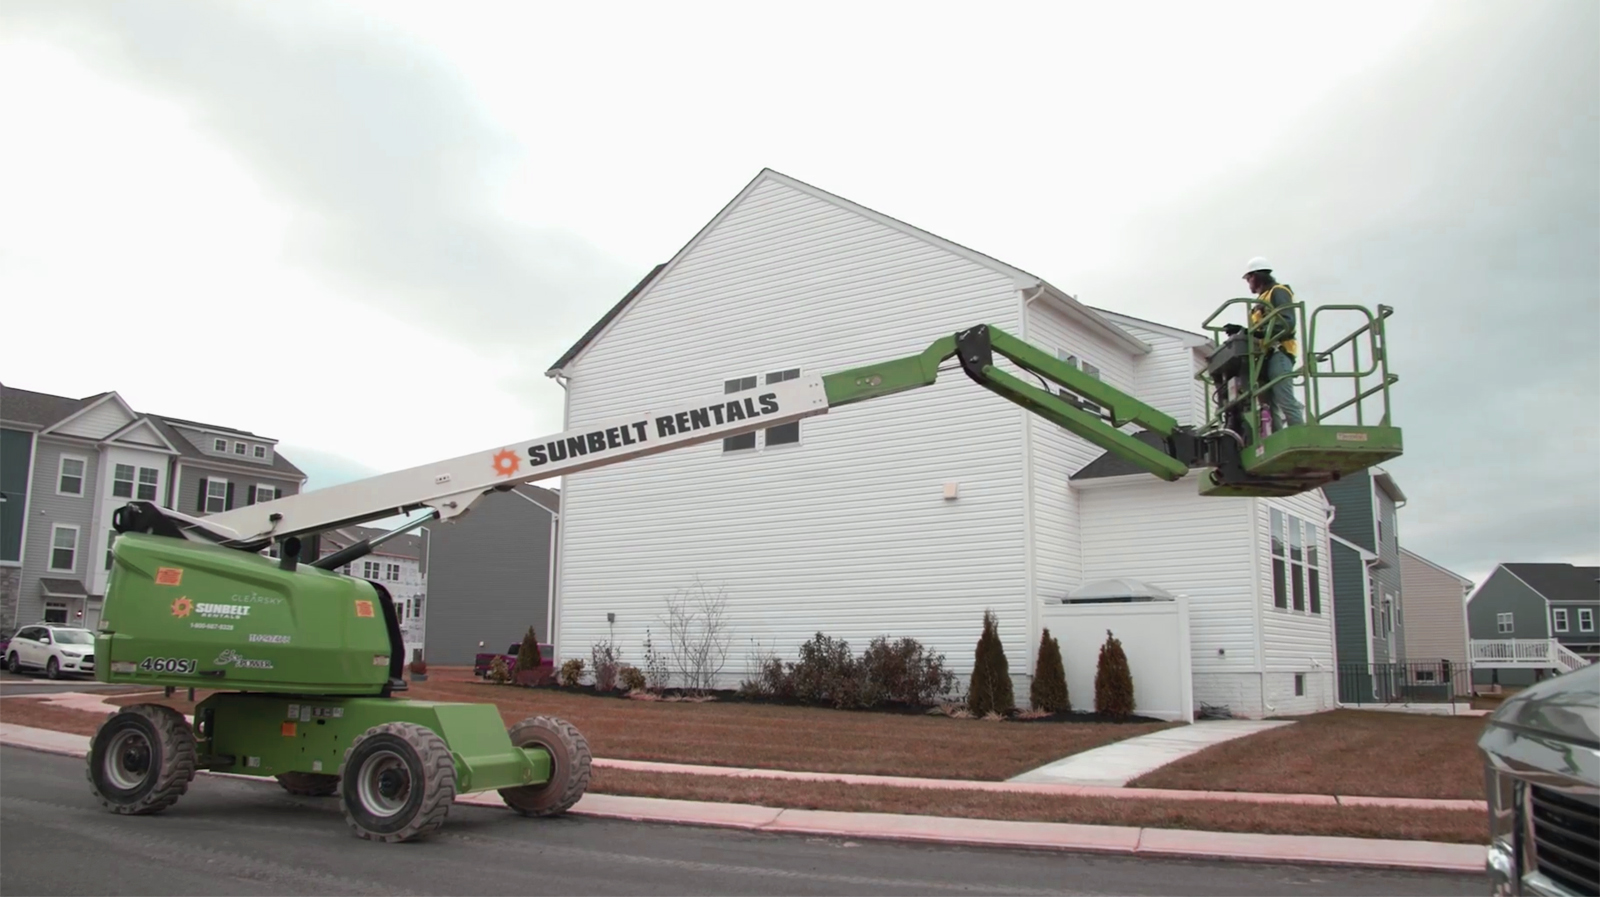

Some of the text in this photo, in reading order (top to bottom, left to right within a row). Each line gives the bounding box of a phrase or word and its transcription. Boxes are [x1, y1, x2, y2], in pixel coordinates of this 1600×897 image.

[528, 392, 780, 467] SUNBELT RENTALS
[195, 602, 251, 616] SUNBELT
[140, 656, 198, 674] 460SJ
